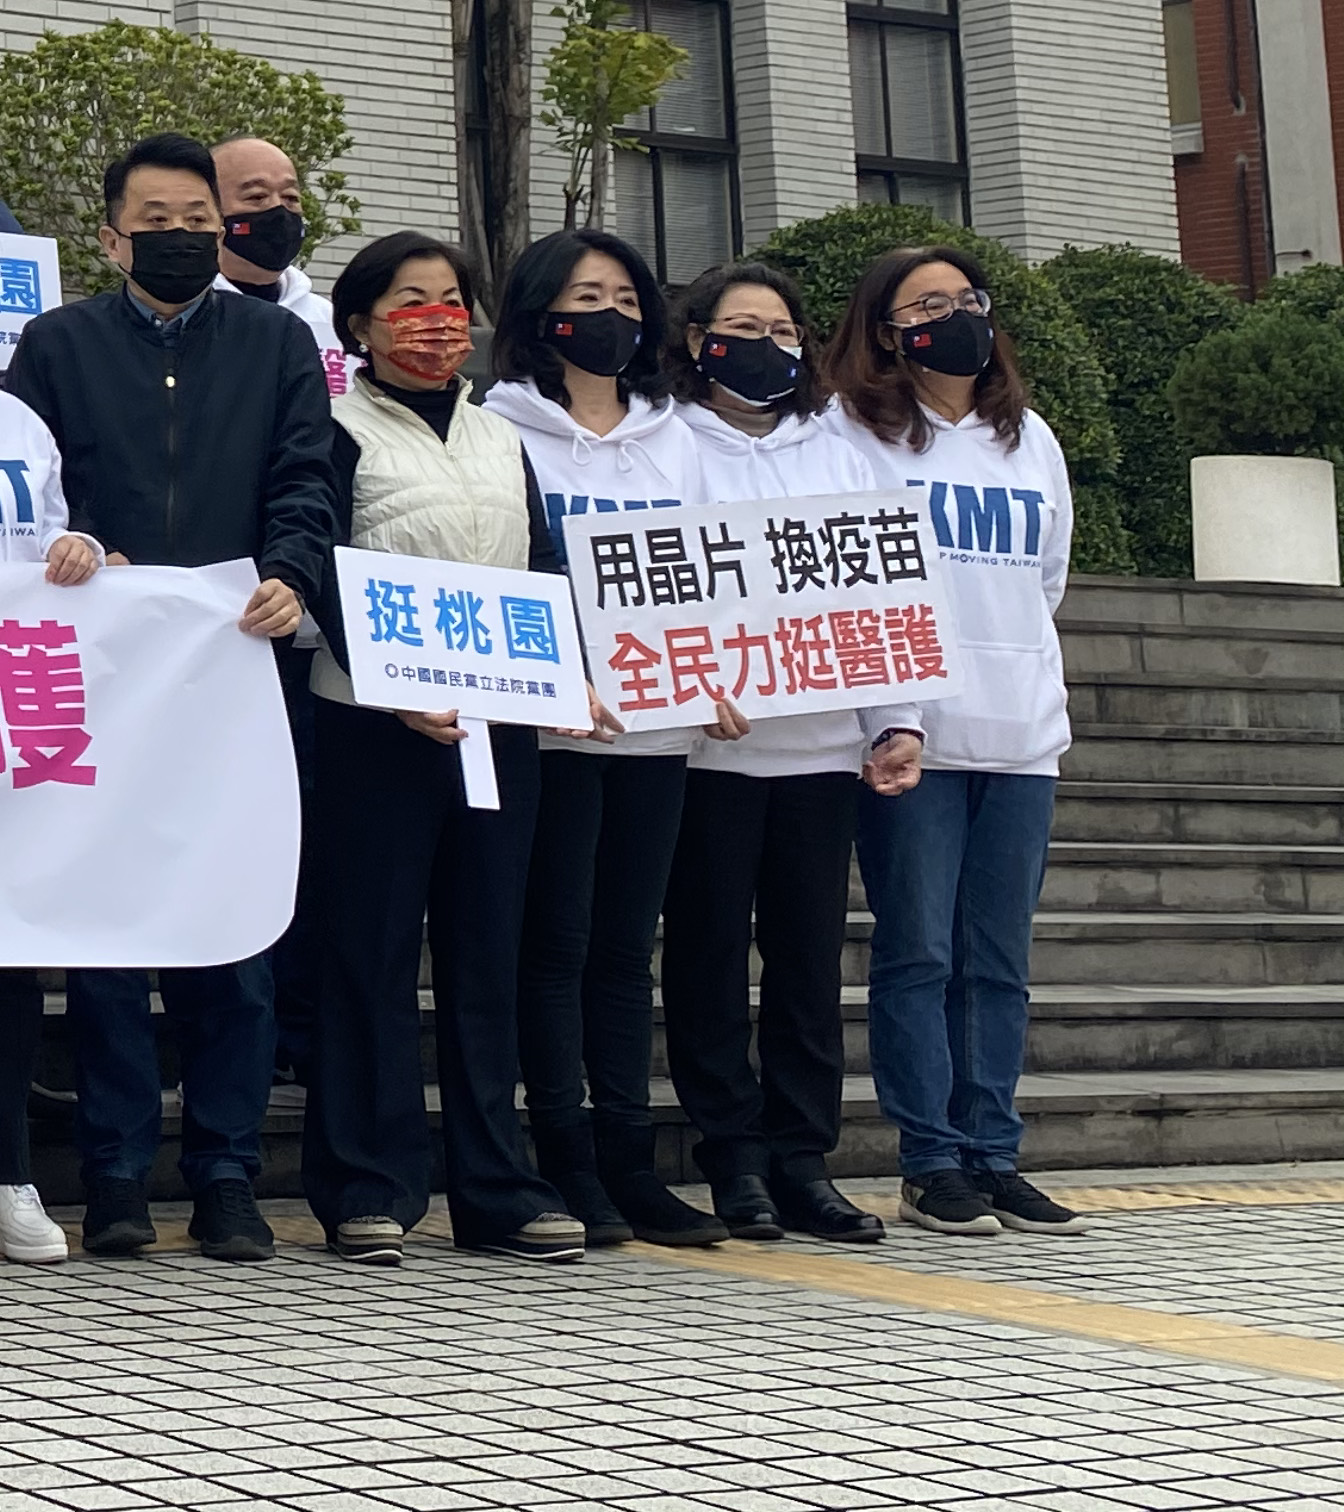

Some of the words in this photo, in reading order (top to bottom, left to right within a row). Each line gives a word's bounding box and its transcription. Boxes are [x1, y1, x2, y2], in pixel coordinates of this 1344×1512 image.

[589, 521, 748, 610] 用晶片
[764, 506, 928, 594] 換疫苗
[363, 577, 561, 665] 挺桃園
[608, 603, 948, 712] 全民力挺醫護
[401, 665, 557, 699] 中國國民黨立法院黨團
